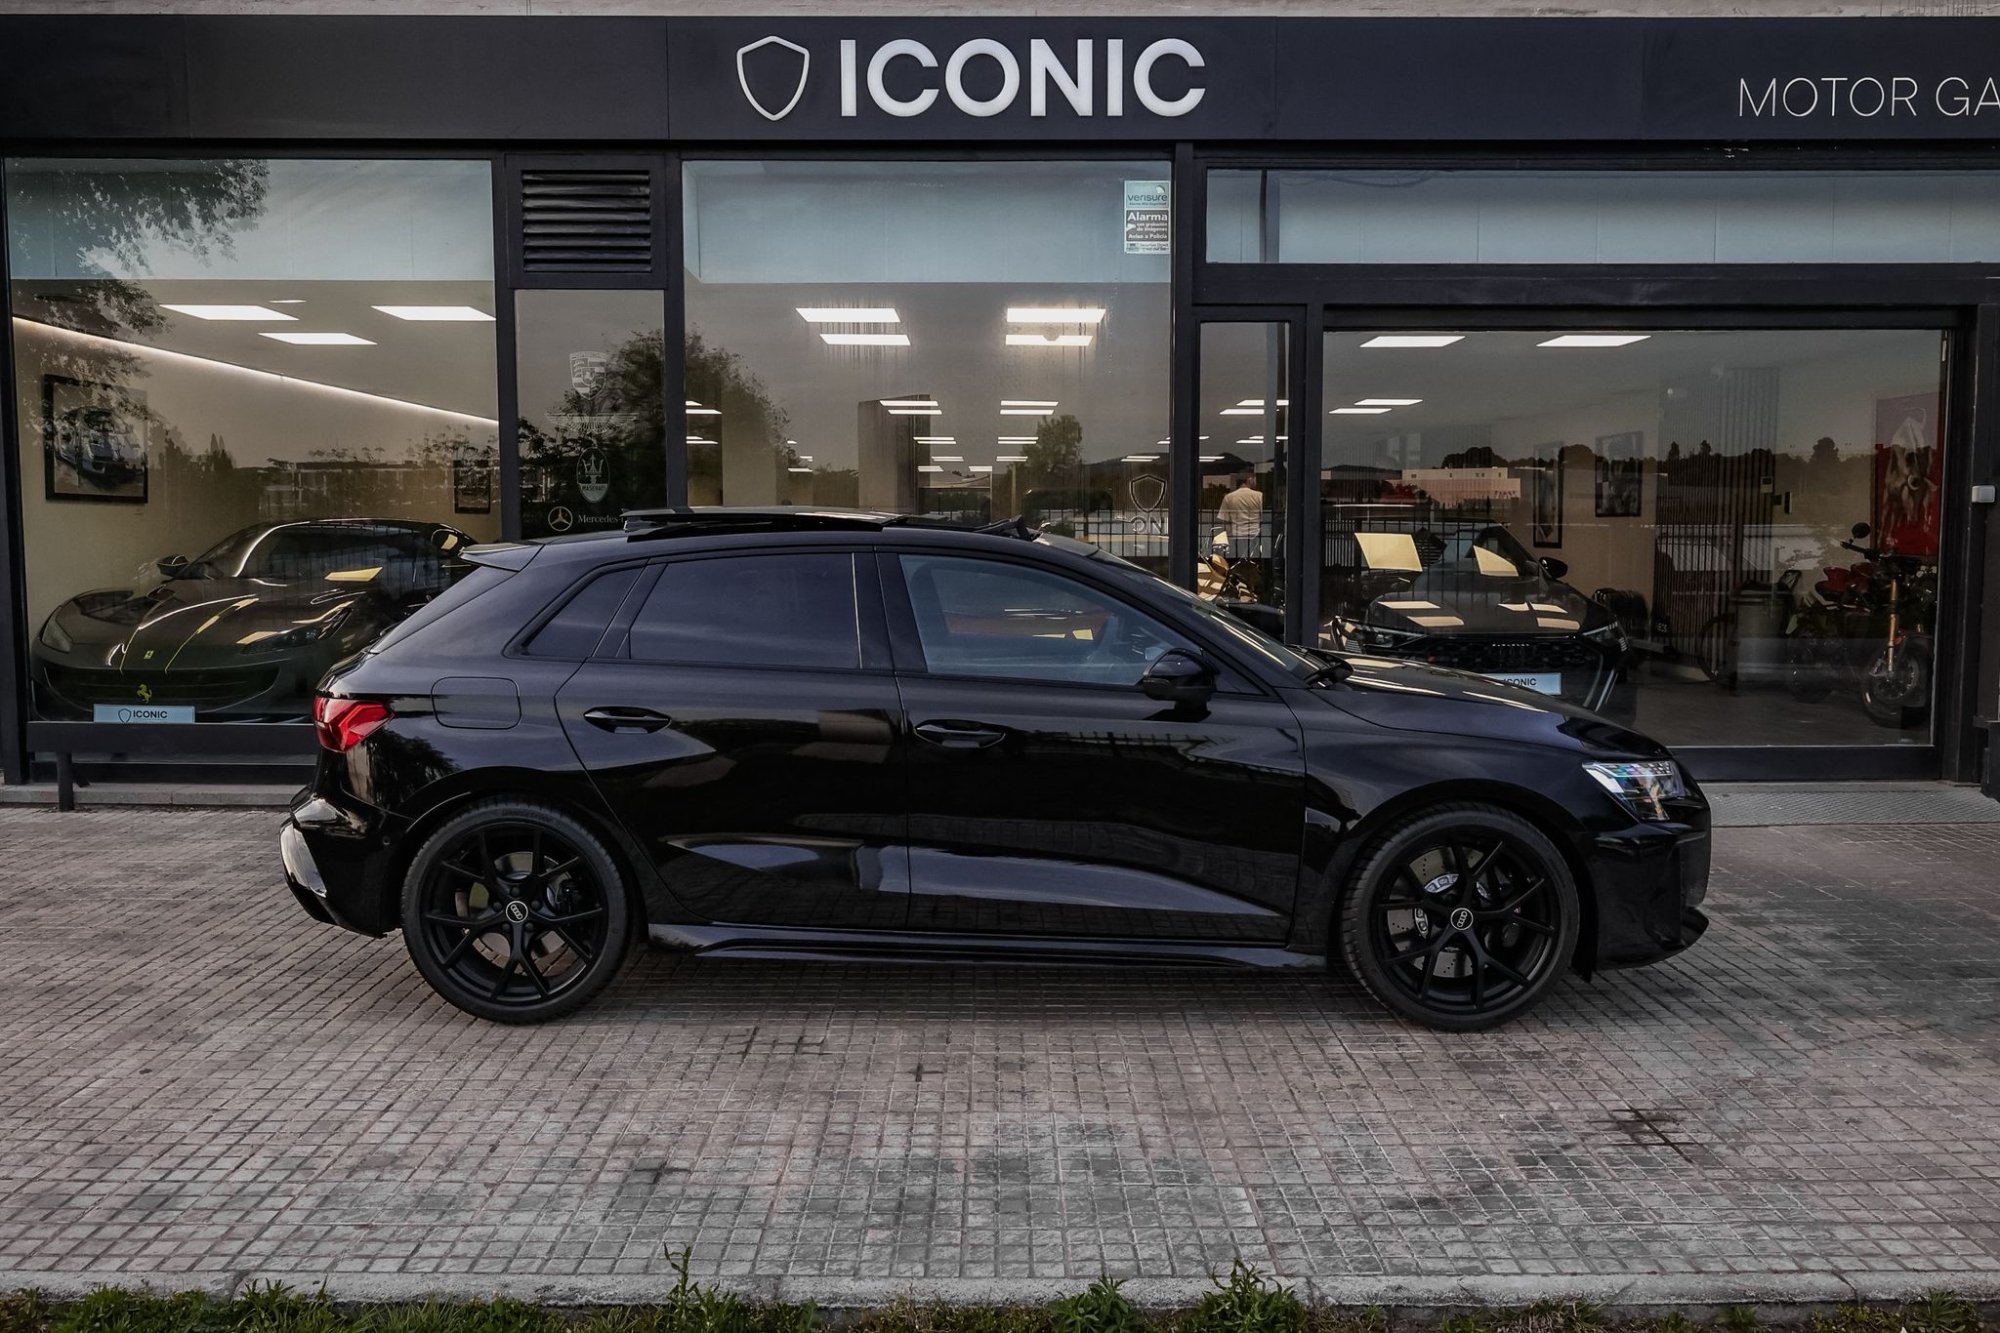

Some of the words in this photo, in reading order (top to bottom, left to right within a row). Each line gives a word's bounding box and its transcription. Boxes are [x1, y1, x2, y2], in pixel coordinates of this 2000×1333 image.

[840, 38, 1206, 117] ICONIC
[1739, 77, 1918, 117] MOTOR
[1127, 212, 1168, 221] Alarma
[133, 710, 168, 719] ICONIC
